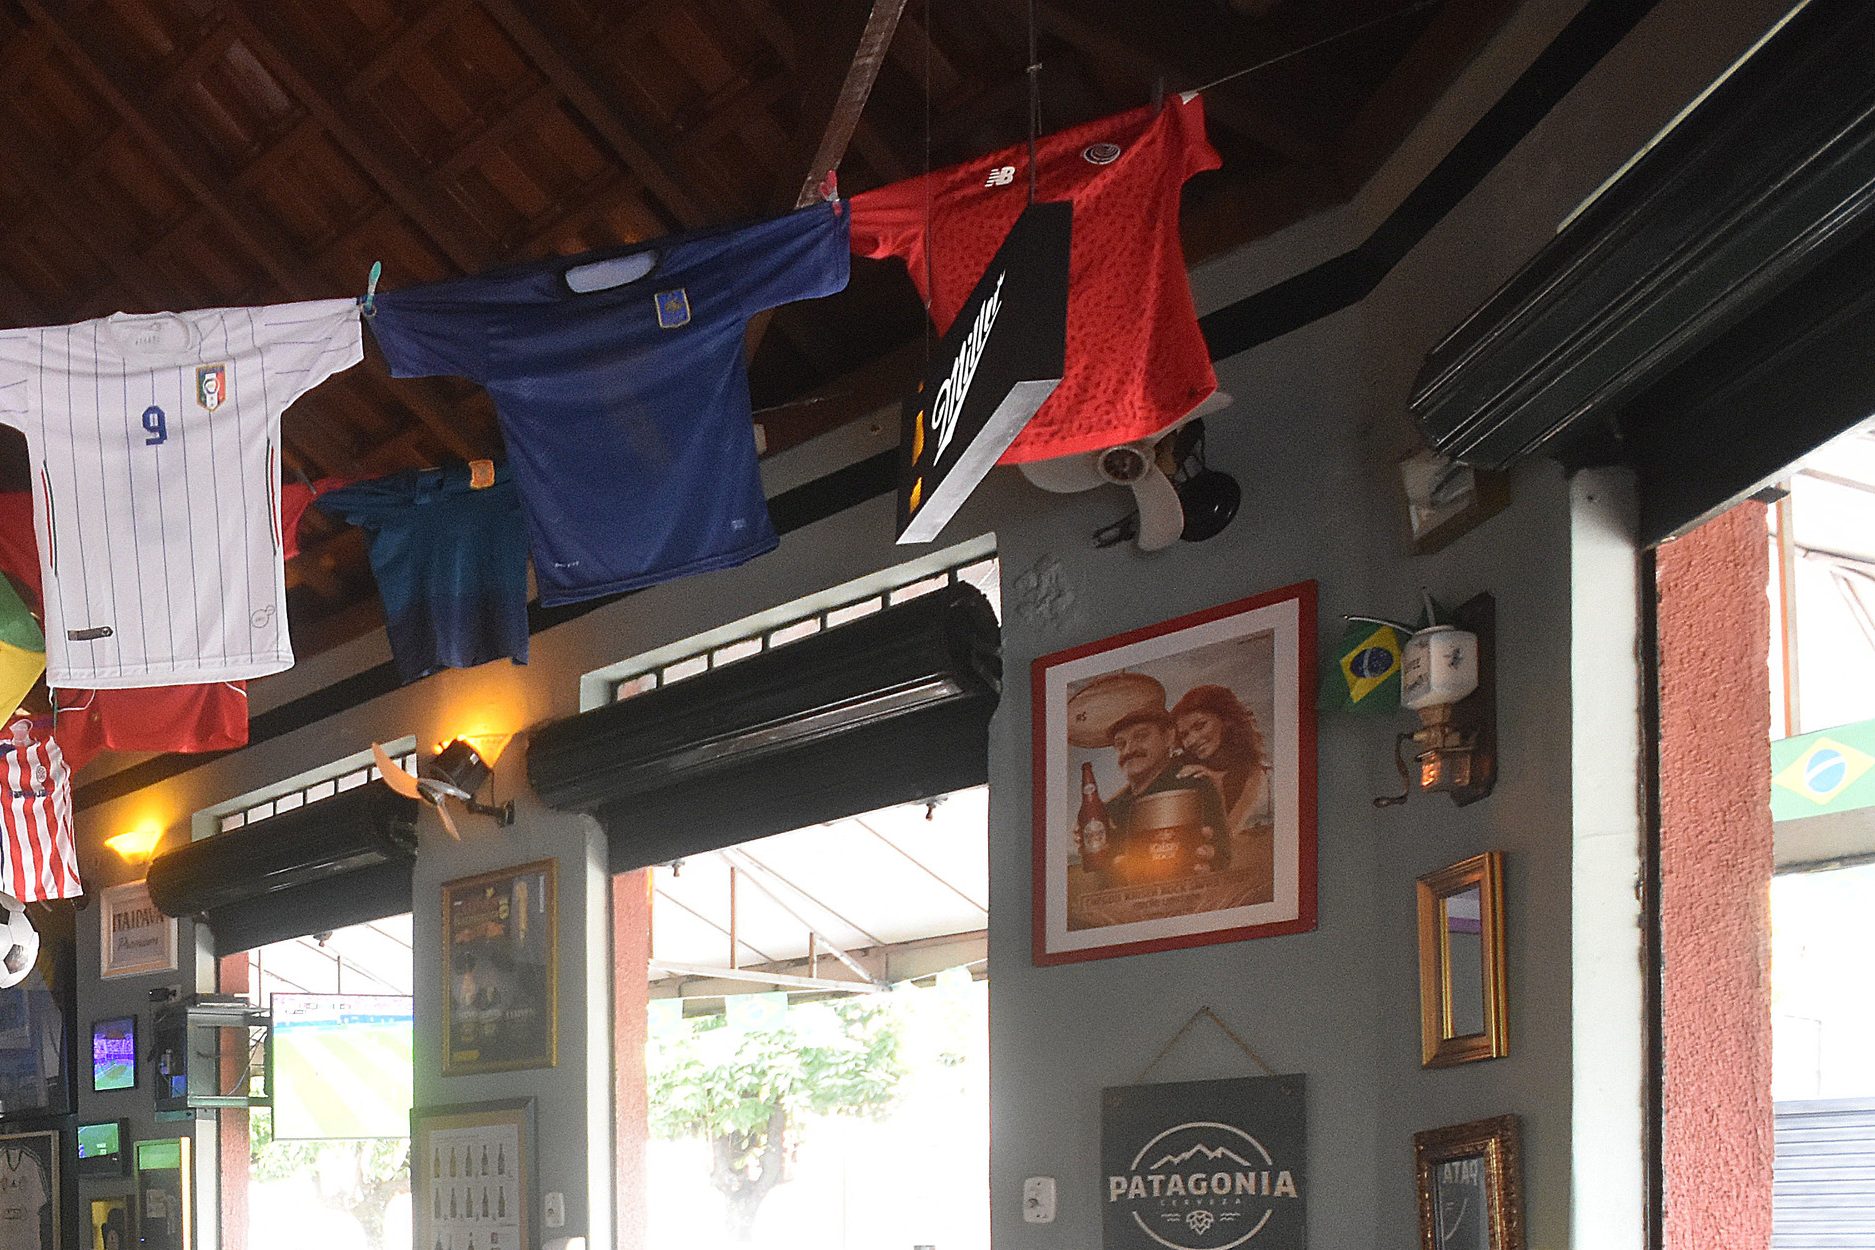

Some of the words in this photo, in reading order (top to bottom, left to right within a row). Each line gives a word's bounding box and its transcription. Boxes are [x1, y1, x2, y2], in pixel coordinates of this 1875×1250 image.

[932, 270, 1006, 466] Miller
[142, 405, 168, 446] 9
[1109, 1171, 1298, 1202] PATAGONIA
[1131, 1198, 1241, 1206] CERVEZA
